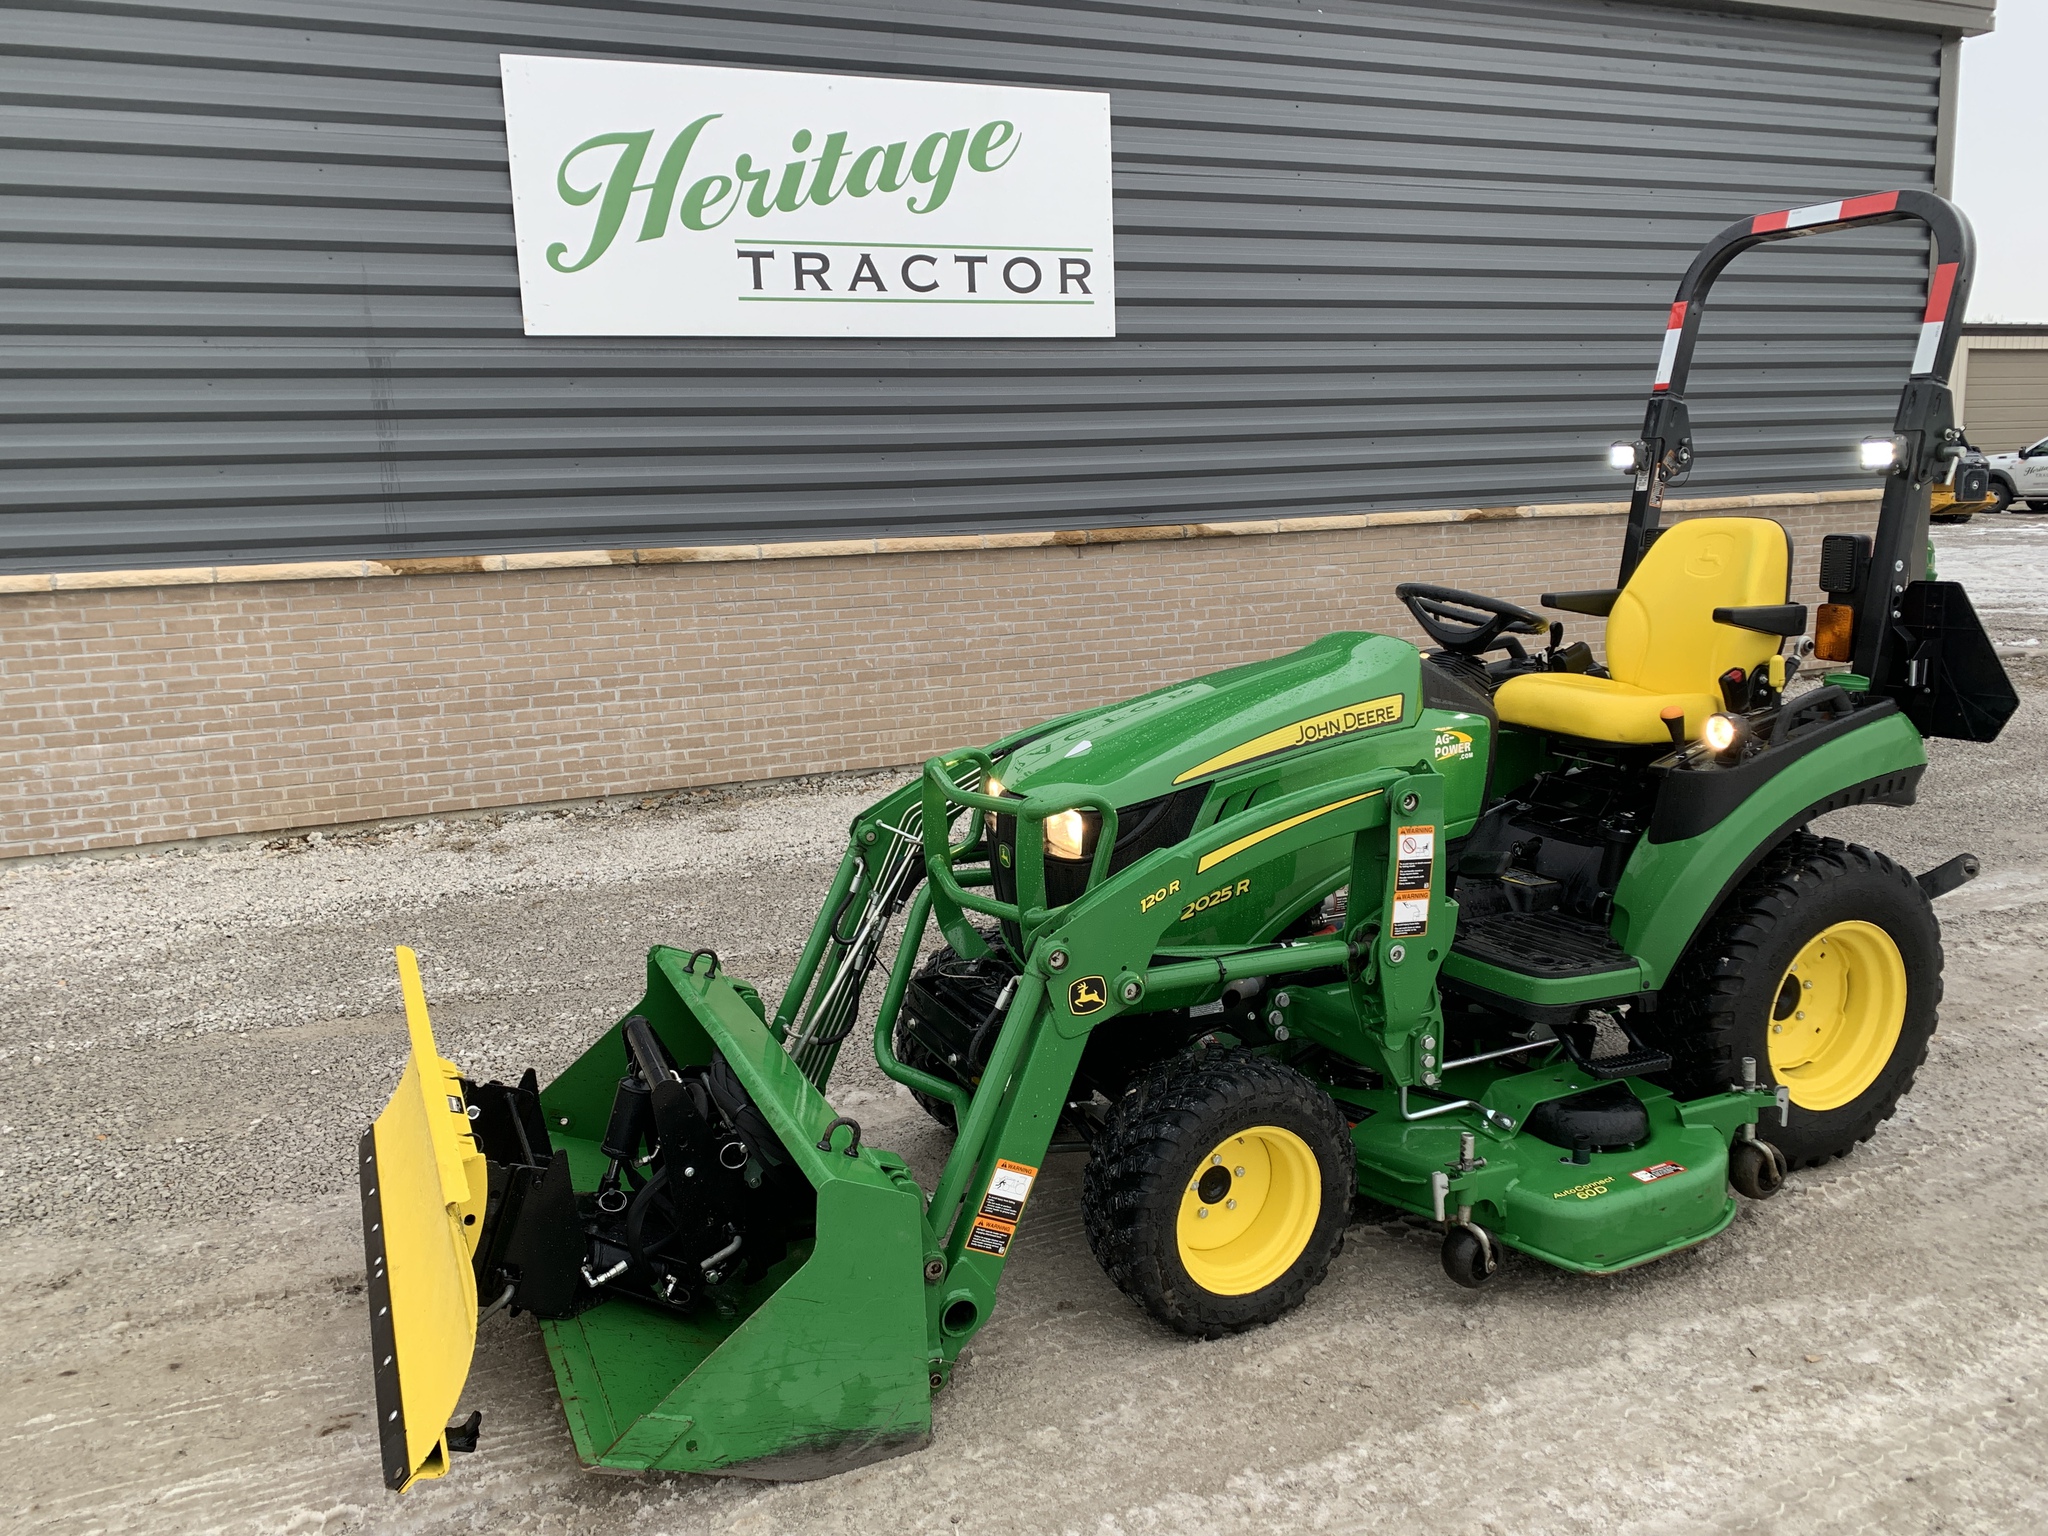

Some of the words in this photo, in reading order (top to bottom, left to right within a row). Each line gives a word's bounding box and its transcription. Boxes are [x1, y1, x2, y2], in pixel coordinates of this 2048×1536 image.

[546, 113, 1022, 273] Heritage
[736, 249, 1093, 295] TRACTOR
[1295, 718, 1341, 743] JOHN
[1343, 705, 1396, 730] DEERE
[1435, 734, 1455, 746] AG-
[1435, 742, 1471, 758] POWER
[1405, 826, 1433, 834] WARNING
[1140, 887, 1167, 914] 120
[1169, 879, 1181, 896] R
[1180, 885, 1234, 921] 2025
[1236, 879, 1251, 896] R
[1401, 892, 1429, 900] WARNING
[1007, 1165, 1033, 1175] WARNING
[1552, 1176, 1616, 1199] AutoConnect
[1576, 1185, 1609, 1200] 60D
[985, 1222, 1011, 1232] WARNING
